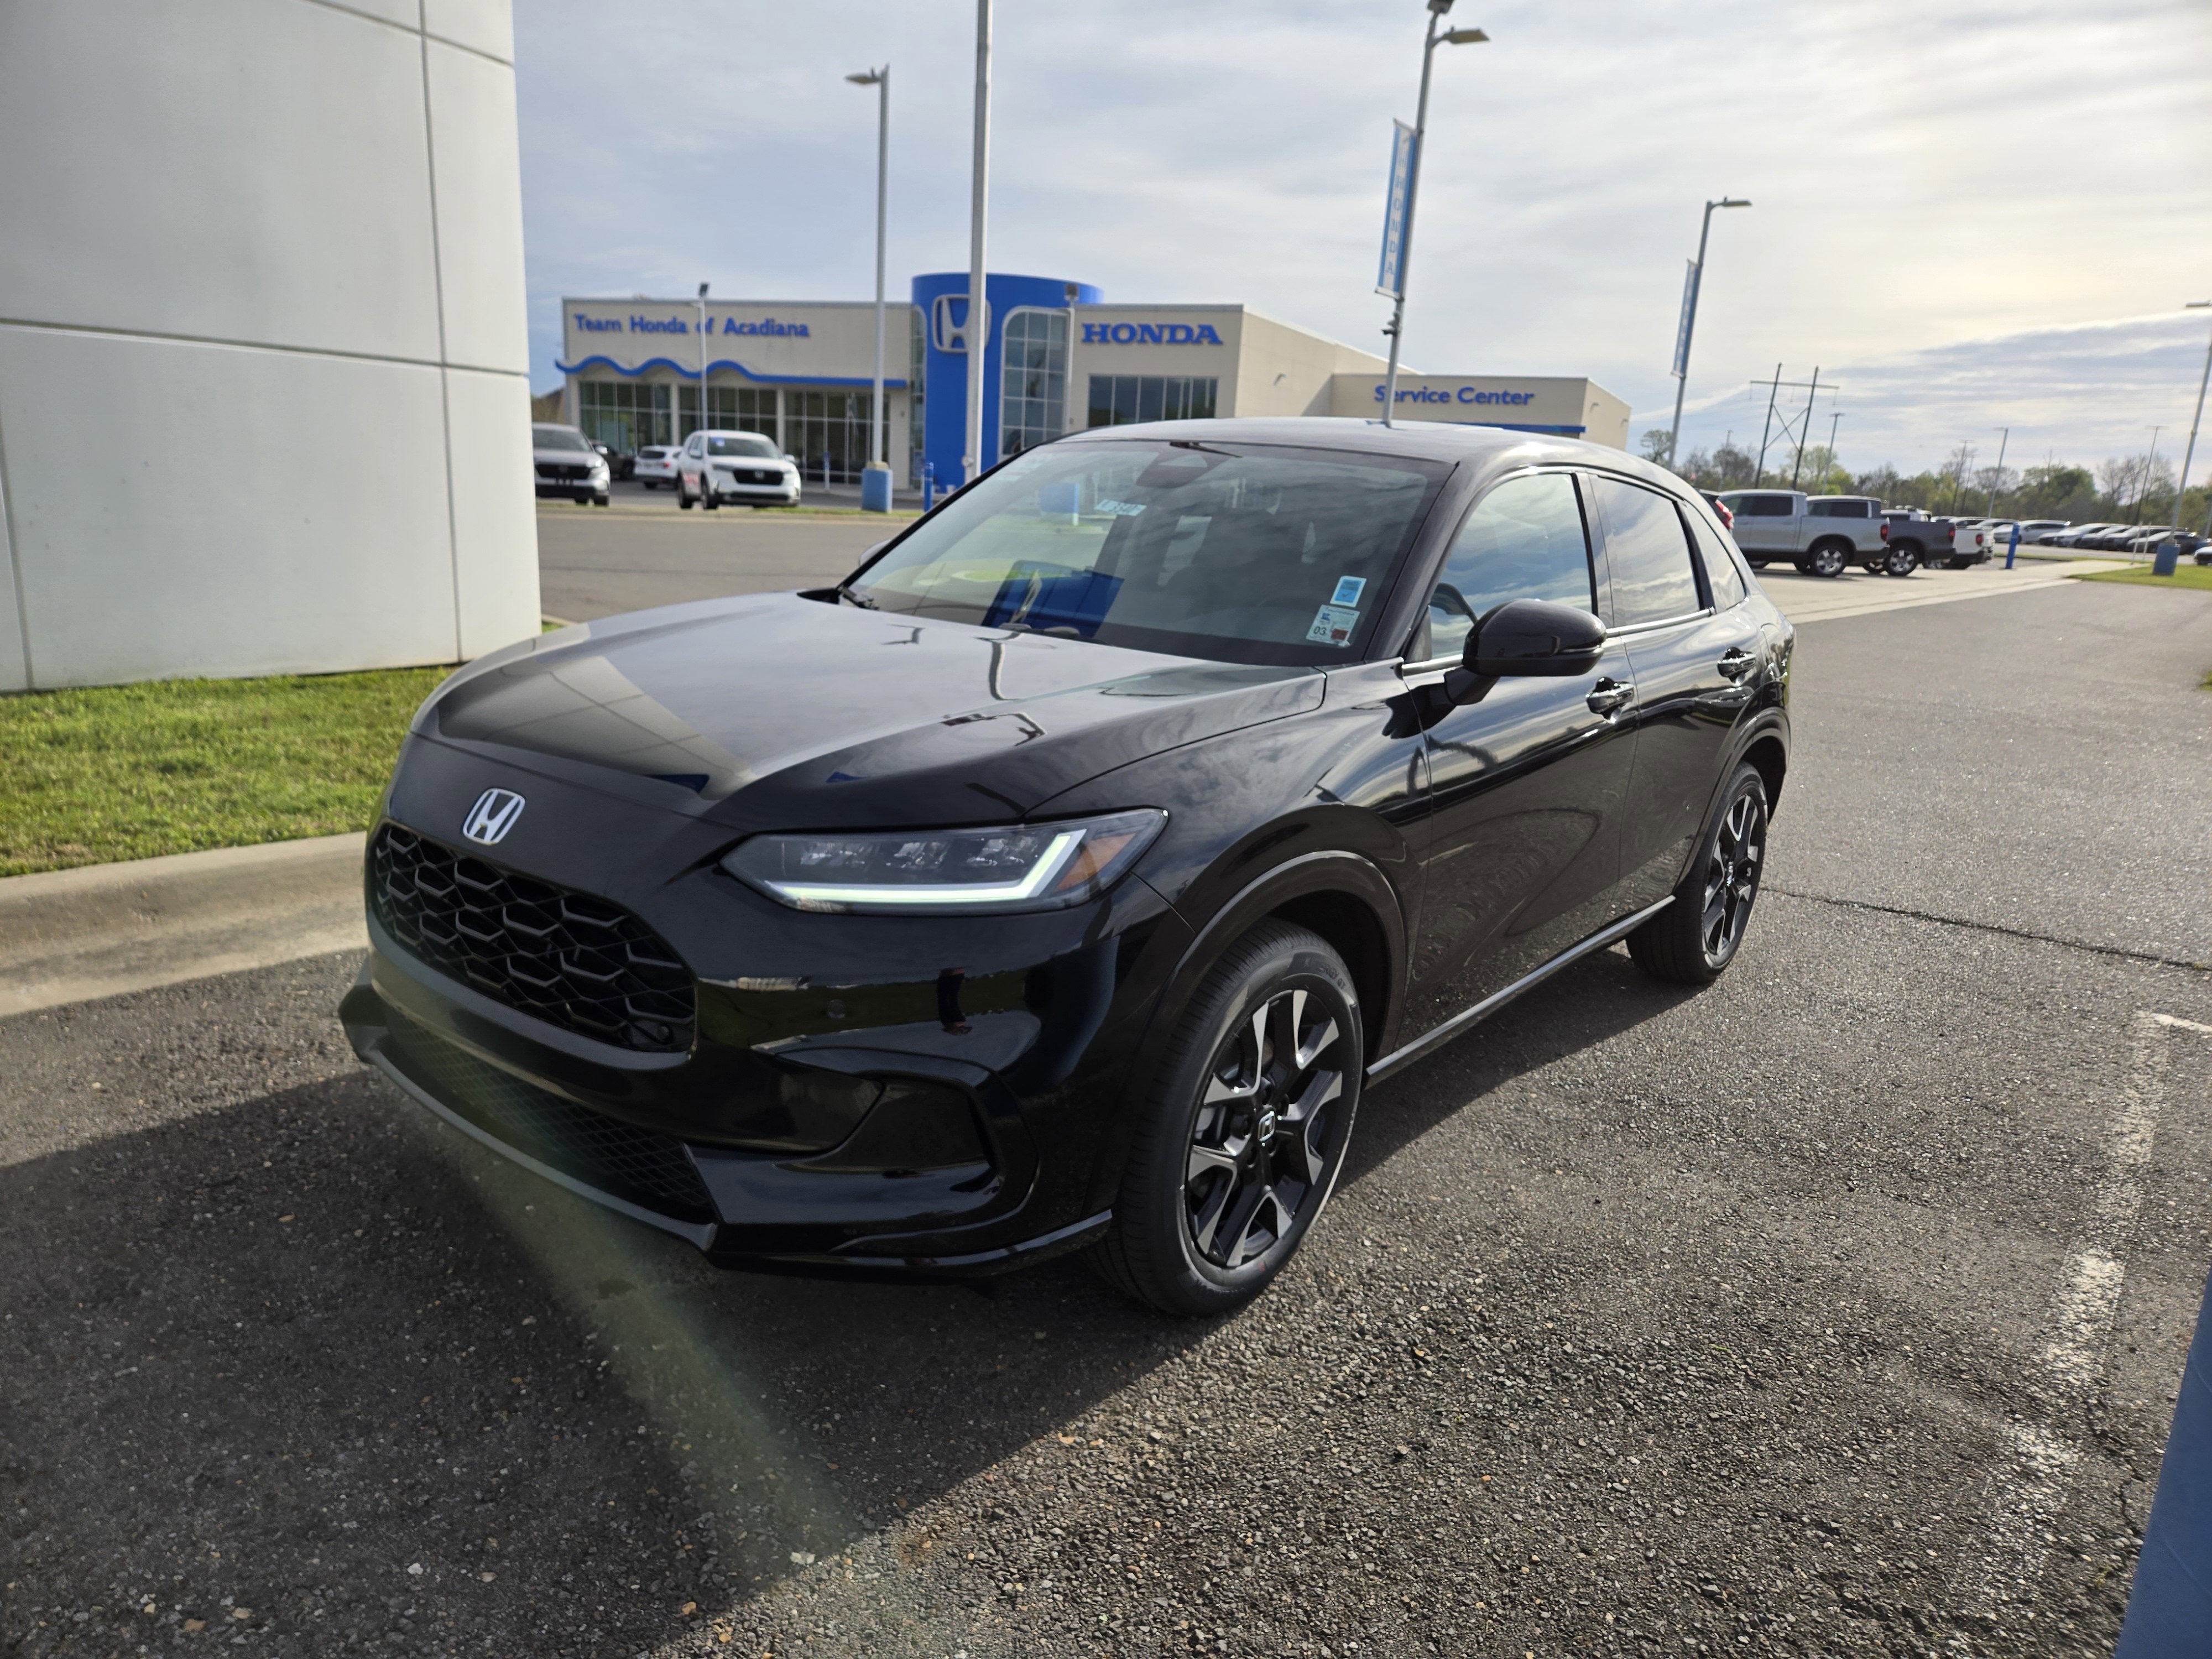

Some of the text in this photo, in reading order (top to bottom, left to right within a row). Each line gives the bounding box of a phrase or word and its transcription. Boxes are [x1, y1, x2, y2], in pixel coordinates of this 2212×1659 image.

[575, 314, 810, 337] Team Honda of Acadiana
[1082, 322, 1223, 345] HONDA
[1374, 385, 1535, 404] Service Center
[1313, 625, 1327, 635] 03
